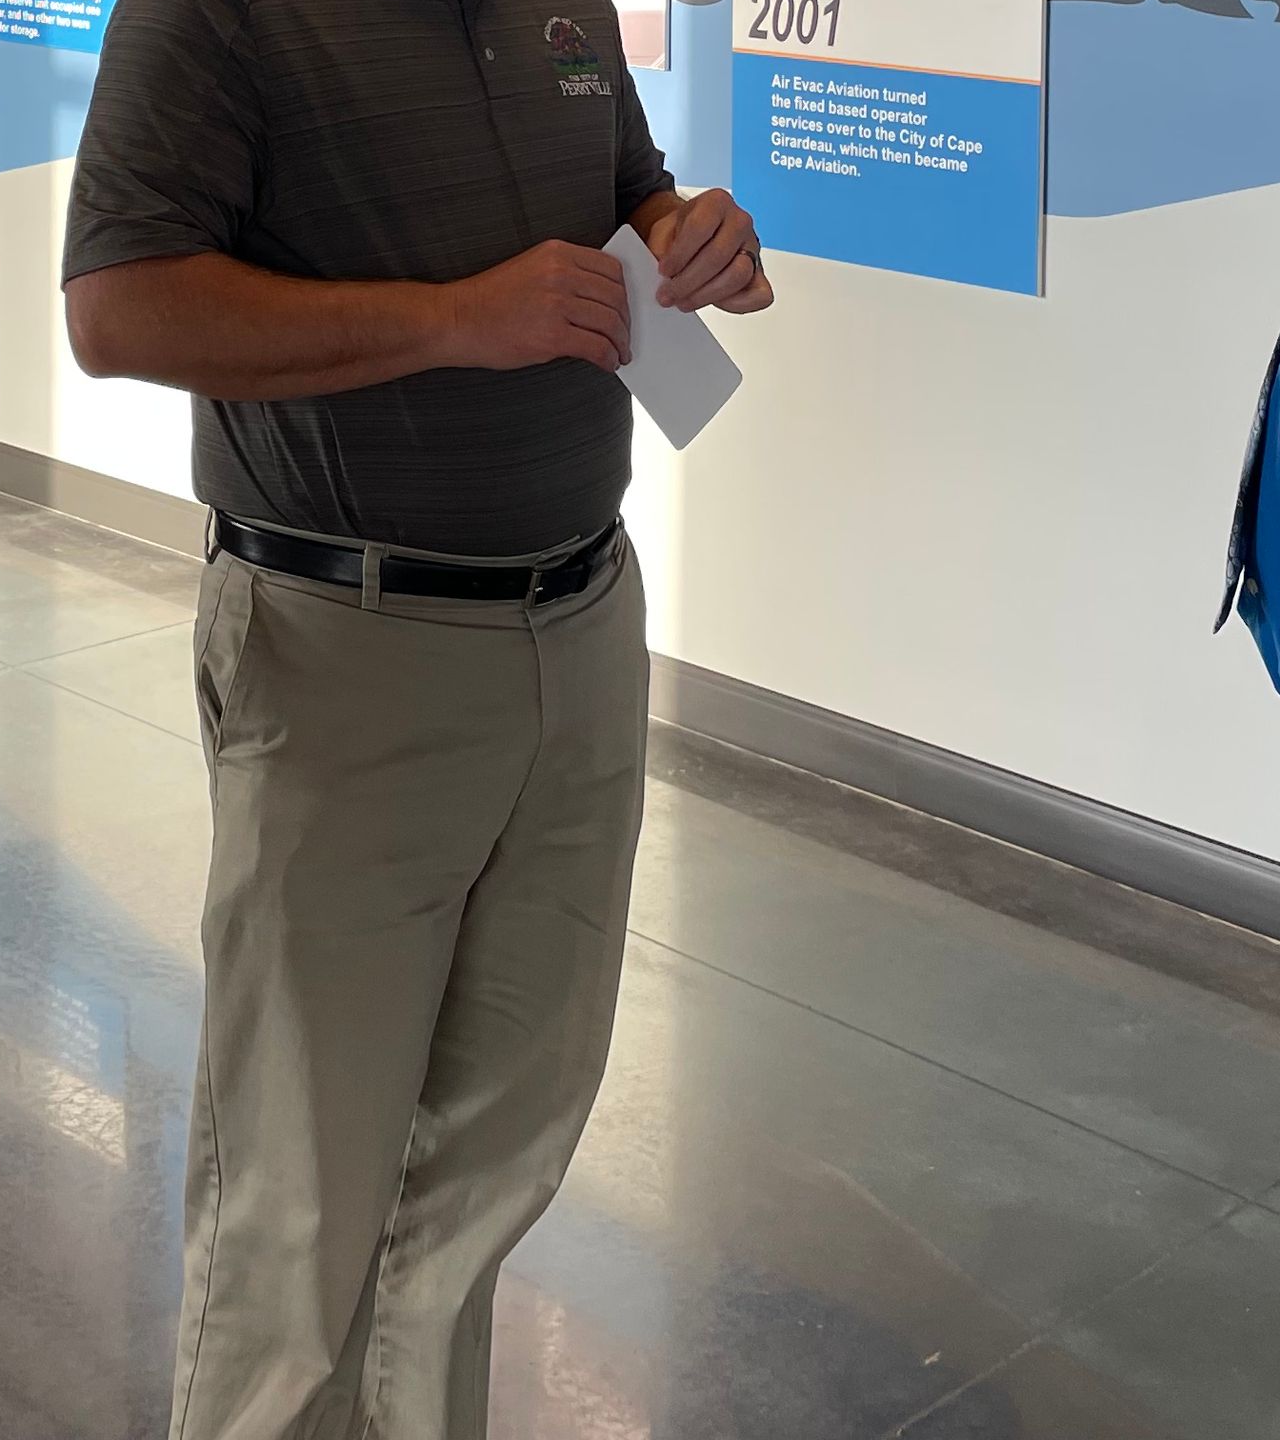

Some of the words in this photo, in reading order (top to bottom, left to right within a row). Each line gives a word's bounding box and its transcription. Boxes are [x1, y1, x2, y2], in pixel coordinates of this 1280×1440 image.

[770, 73, 791, 89] Air
[792, 75, 824, 94] Evac
[825, 79, 880, 100] Aviation
[881, 86, 926, 106] turned
[770, 92, 791, 109] the
[792, 94, 825, 113] fixed
[827, 99, 867, 119] based
[870, 107, 928, 126] operator
[770, 114, 824, 133] services
[825, 121, 856, 137] over
[857, 123, 872, 139] to
[874, 125, 896, 142] the
[898, 127, 926, 149] City
[928, 133, 944, 148] of
[946, 134, 983, 156] Cape
[770, 130, 836, 155] Girardeau,
[838, 141, 878, 160] which
[880, 146, 911, 164] then
[913, 150, 968, 172] became
[769, 149, 803, 170] Cape
[804, 154, 861, 177] Aviation.
